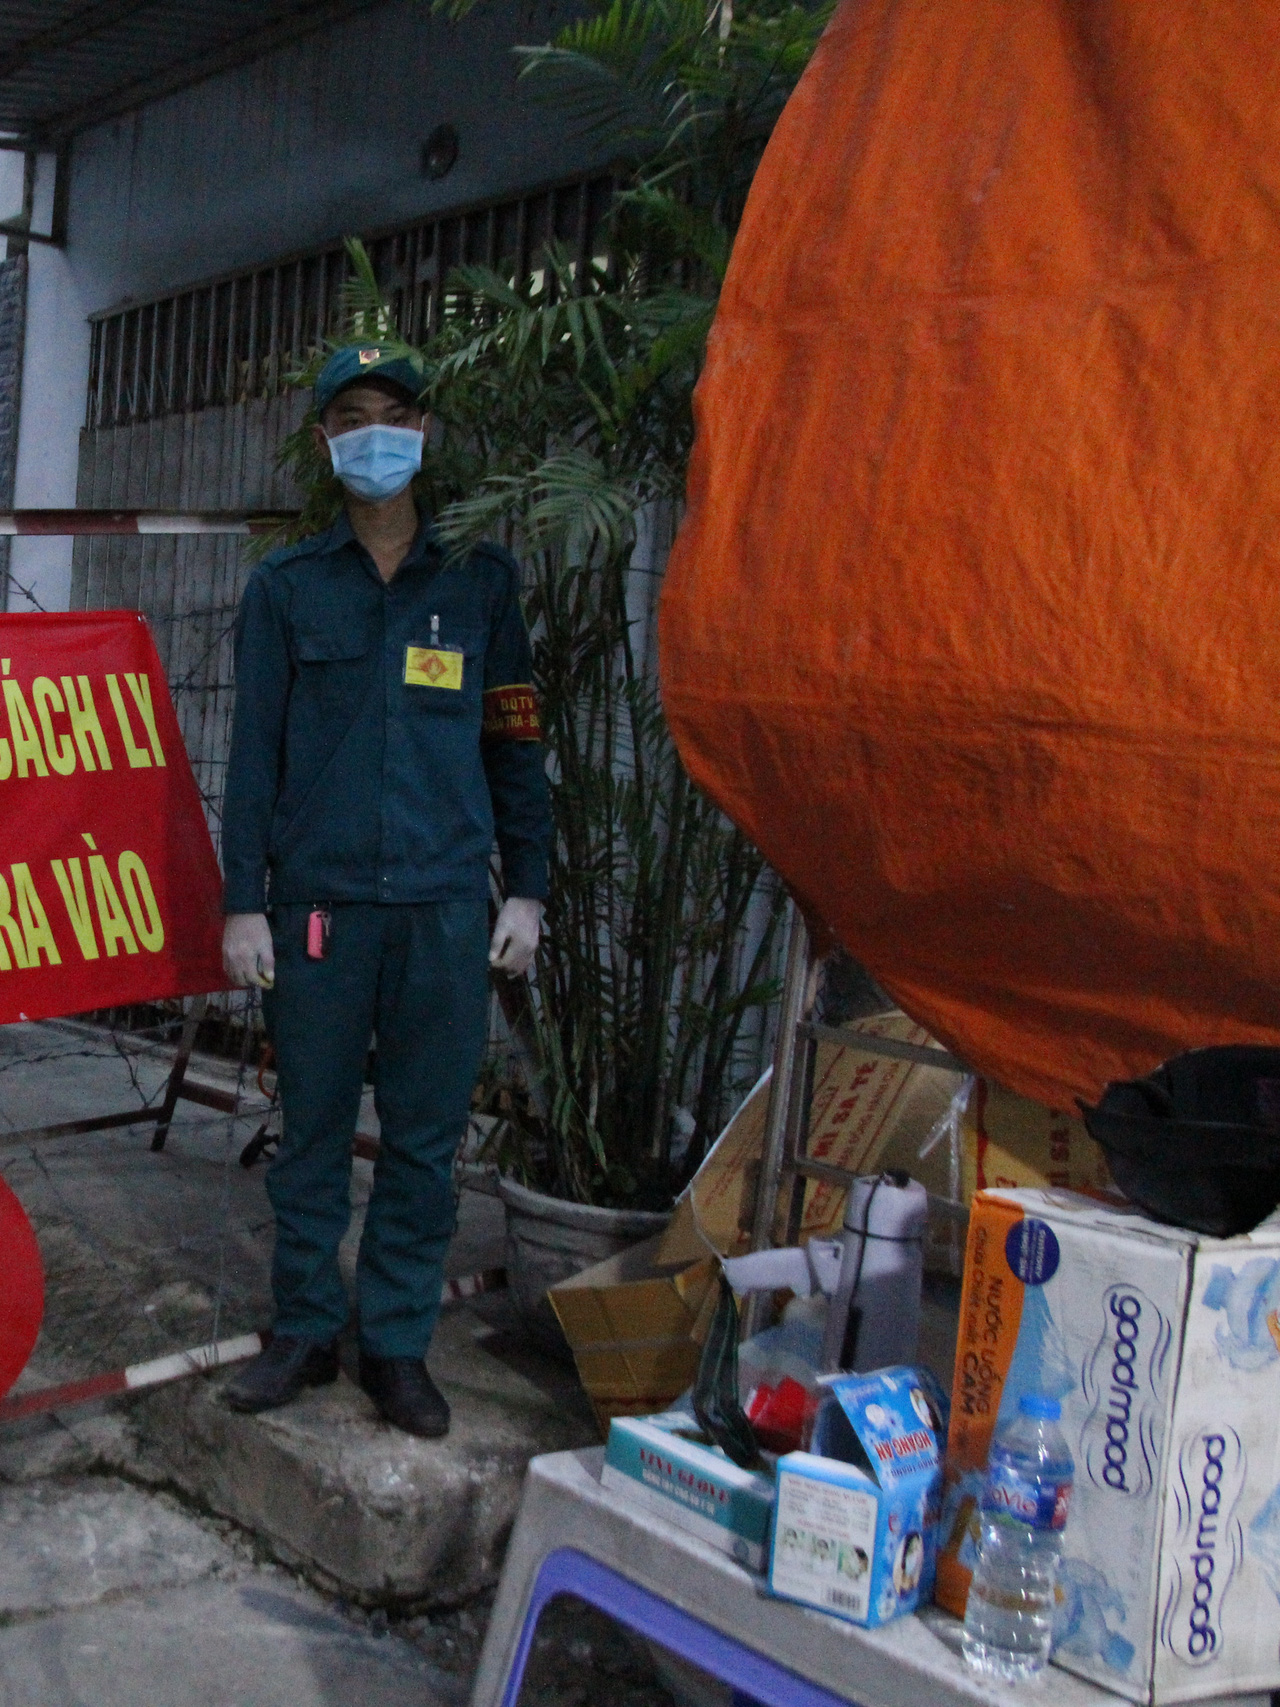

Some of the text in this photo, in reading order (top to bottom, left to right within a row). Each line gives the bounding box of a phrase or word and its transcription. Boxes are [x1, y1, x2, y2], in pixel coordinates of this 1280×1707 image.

[106, 673, 166, 769] LY
[51, 833, 165, 961] VÀO
[960, 1351, 979, 1415] CAM
[1102, 1292, 1141, 1493] goodmood
[1188, 1433, 1226, 1656] goodmood
